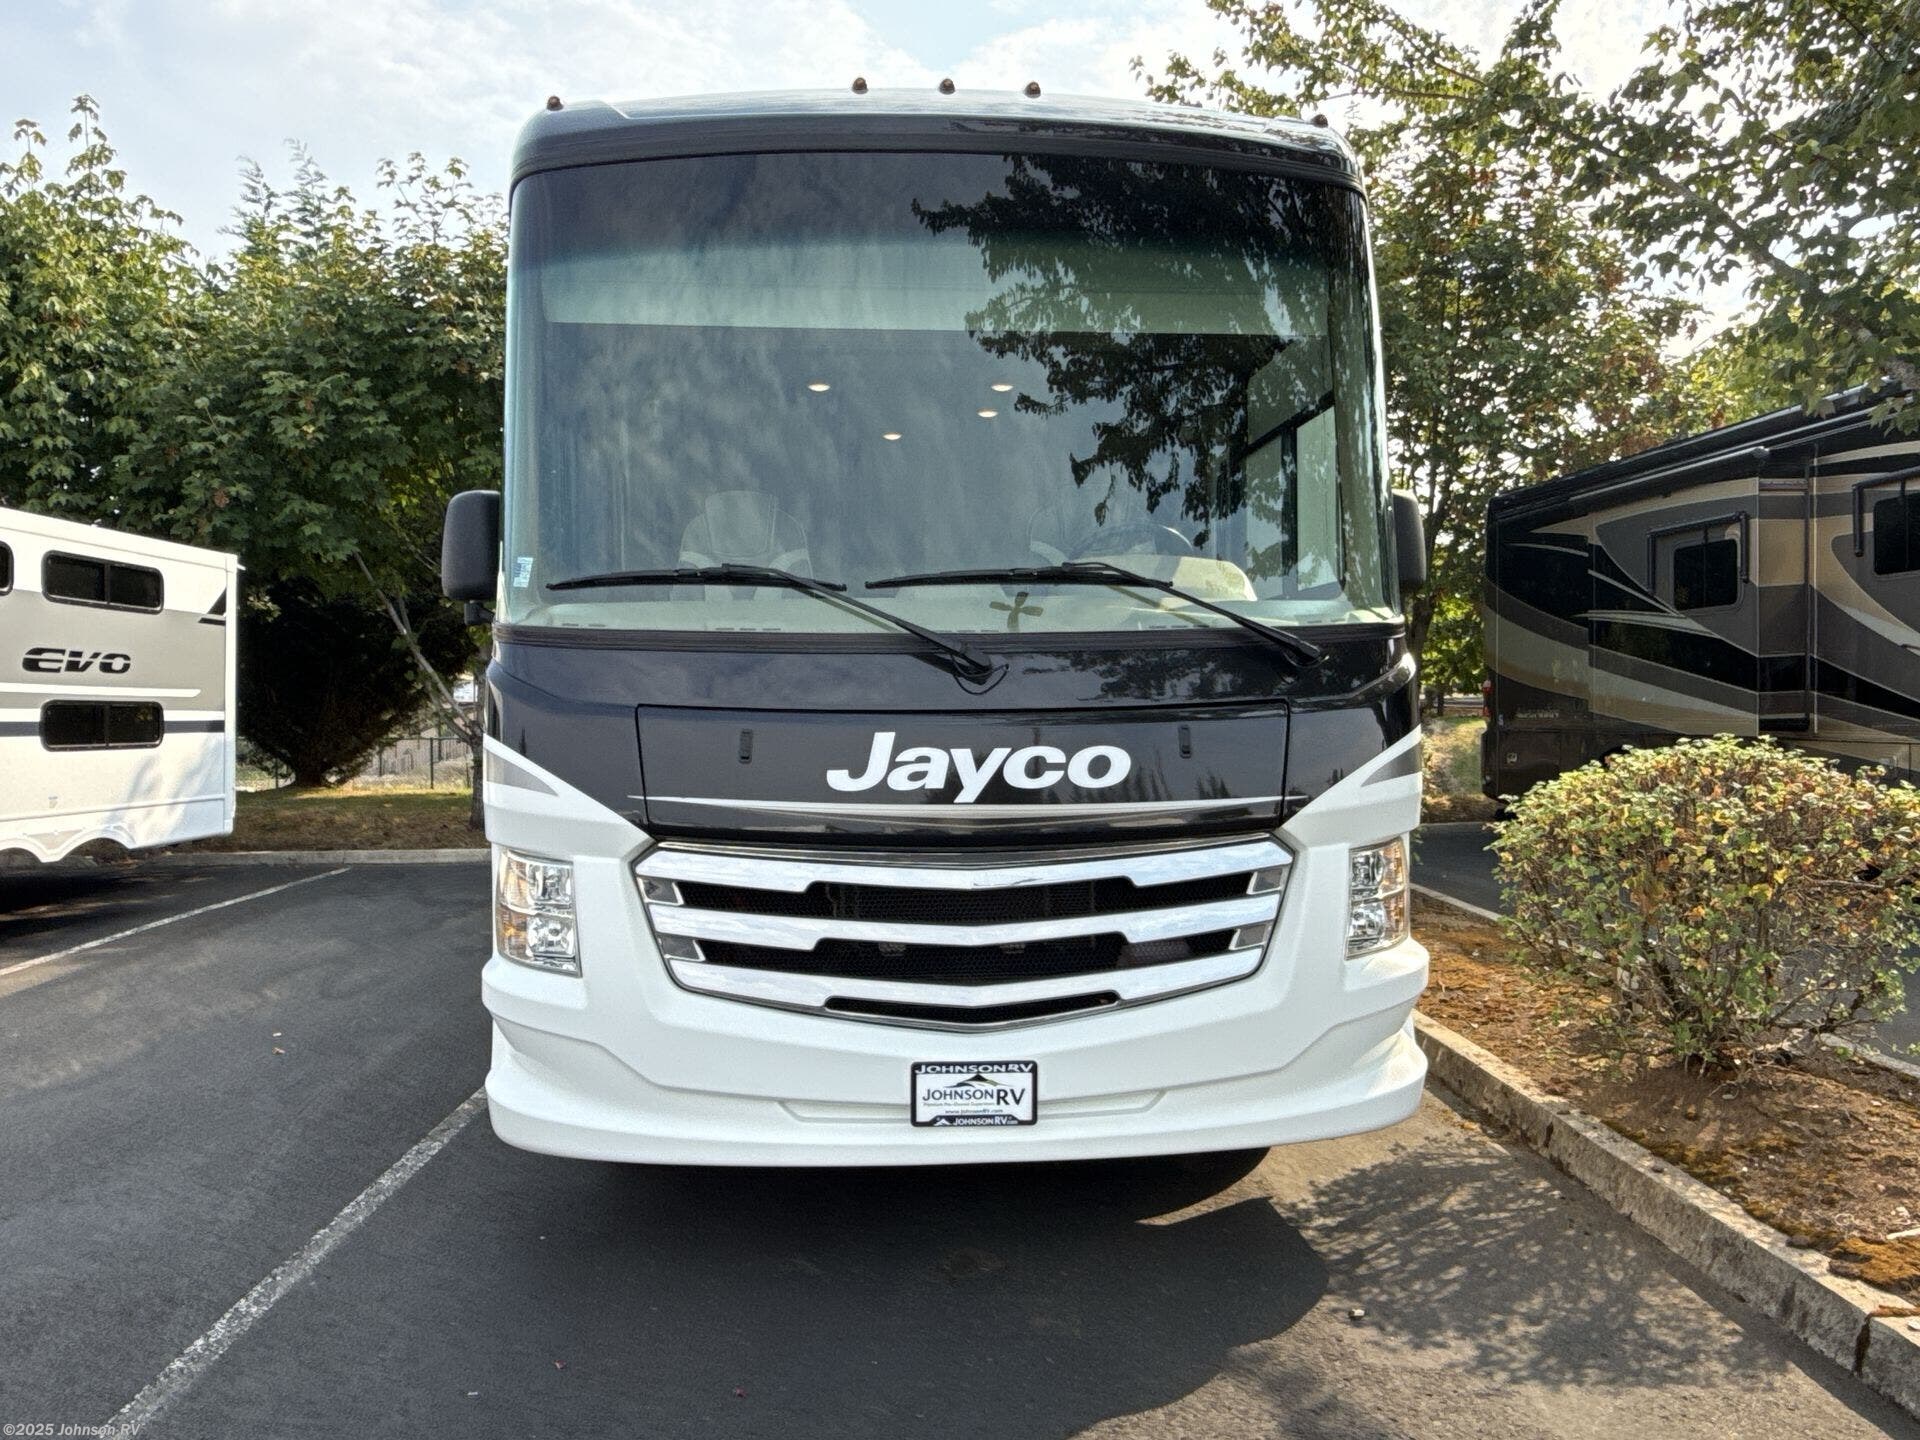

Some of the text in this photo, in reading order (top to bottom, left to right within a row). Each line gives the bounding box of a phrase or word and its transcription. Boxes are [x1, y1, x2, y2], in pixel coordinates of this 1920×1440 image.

[22, 647, 131, 674] EVO
[826, 731, 1132, 804] Jayco
[922, 1088, 1026, 1106] JOHNSON RV
